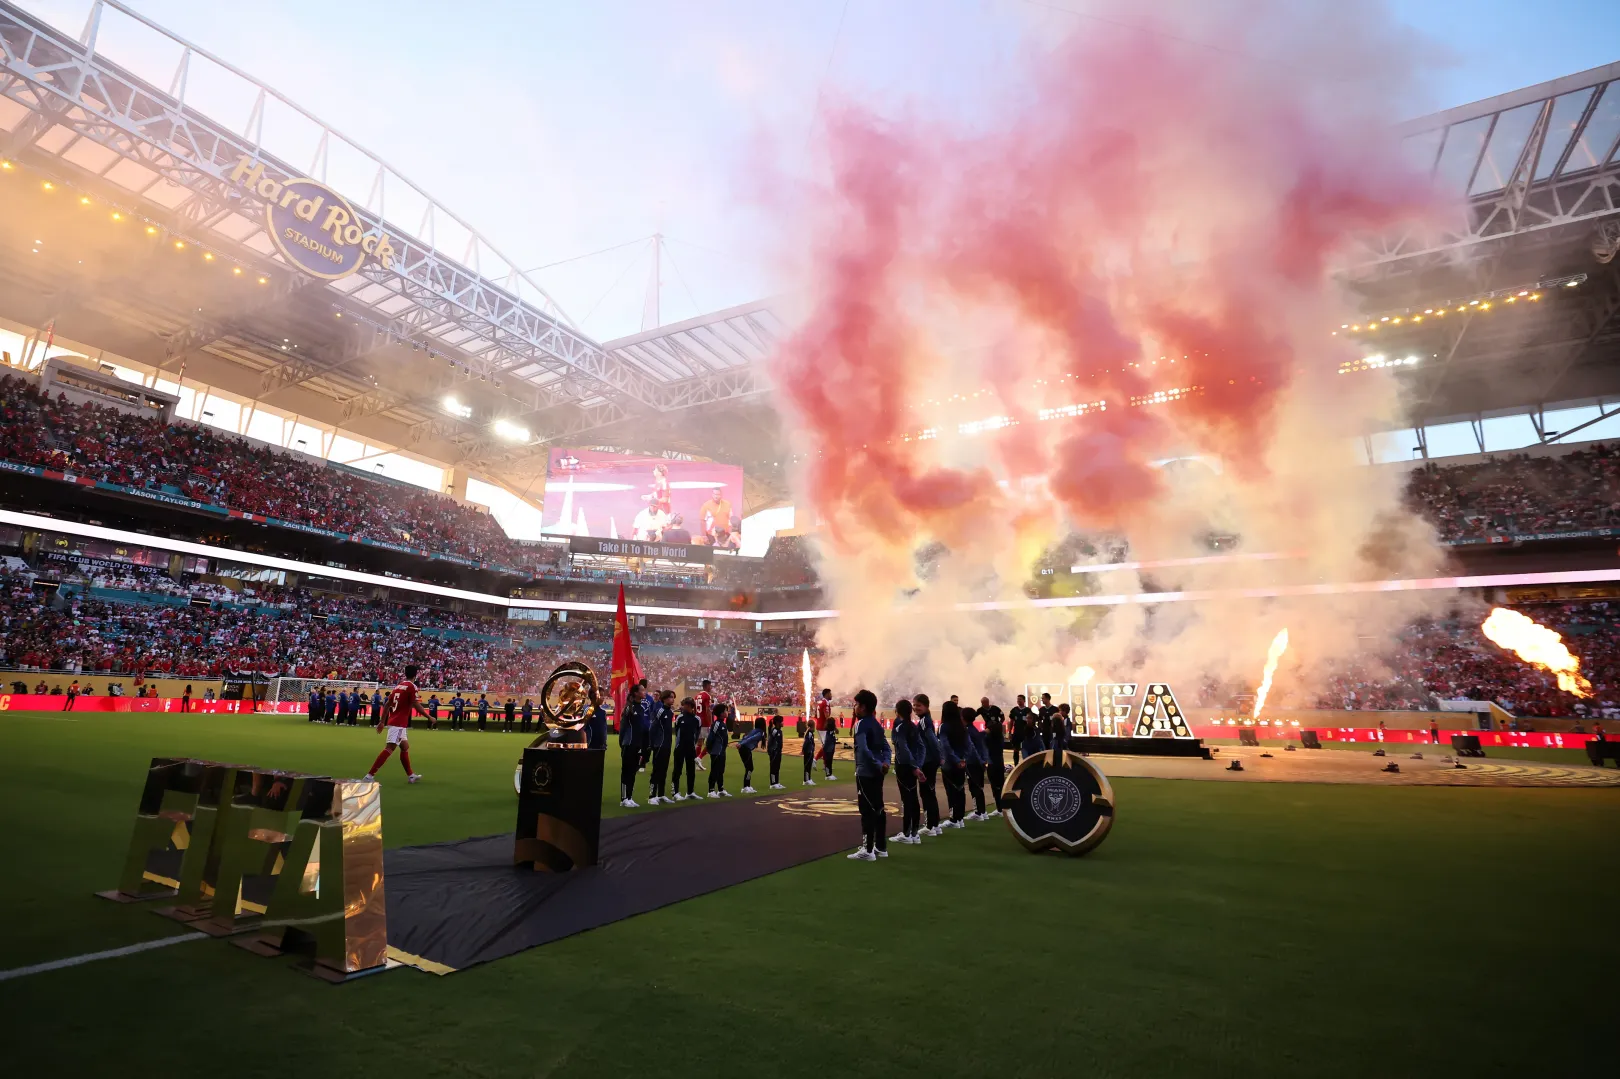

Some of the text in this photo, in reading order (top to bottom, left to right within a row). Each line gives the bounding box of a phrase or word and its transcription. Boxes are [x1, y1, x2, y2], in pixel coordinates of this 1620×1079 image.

[230, 153, 395, 269] Hard Rock
[284, 226, 344, 265] STADIUM
[0, 461, 36, 474] DEZ 75
[129, 488, 156, 500] JASON
[159, 494, 189, 506] TAYLOR
[282, 521, 300, 530] ZACH
[302, 525, 326, 536] THOMAS
[598, 542, 687, 558] Take It To The World
[48, 552, 67, 561] FIFA
[68, 555, 91, 564] CLUB
[91, 558, 121, 569] WORLD
[392, 692, 400, 712] 5
